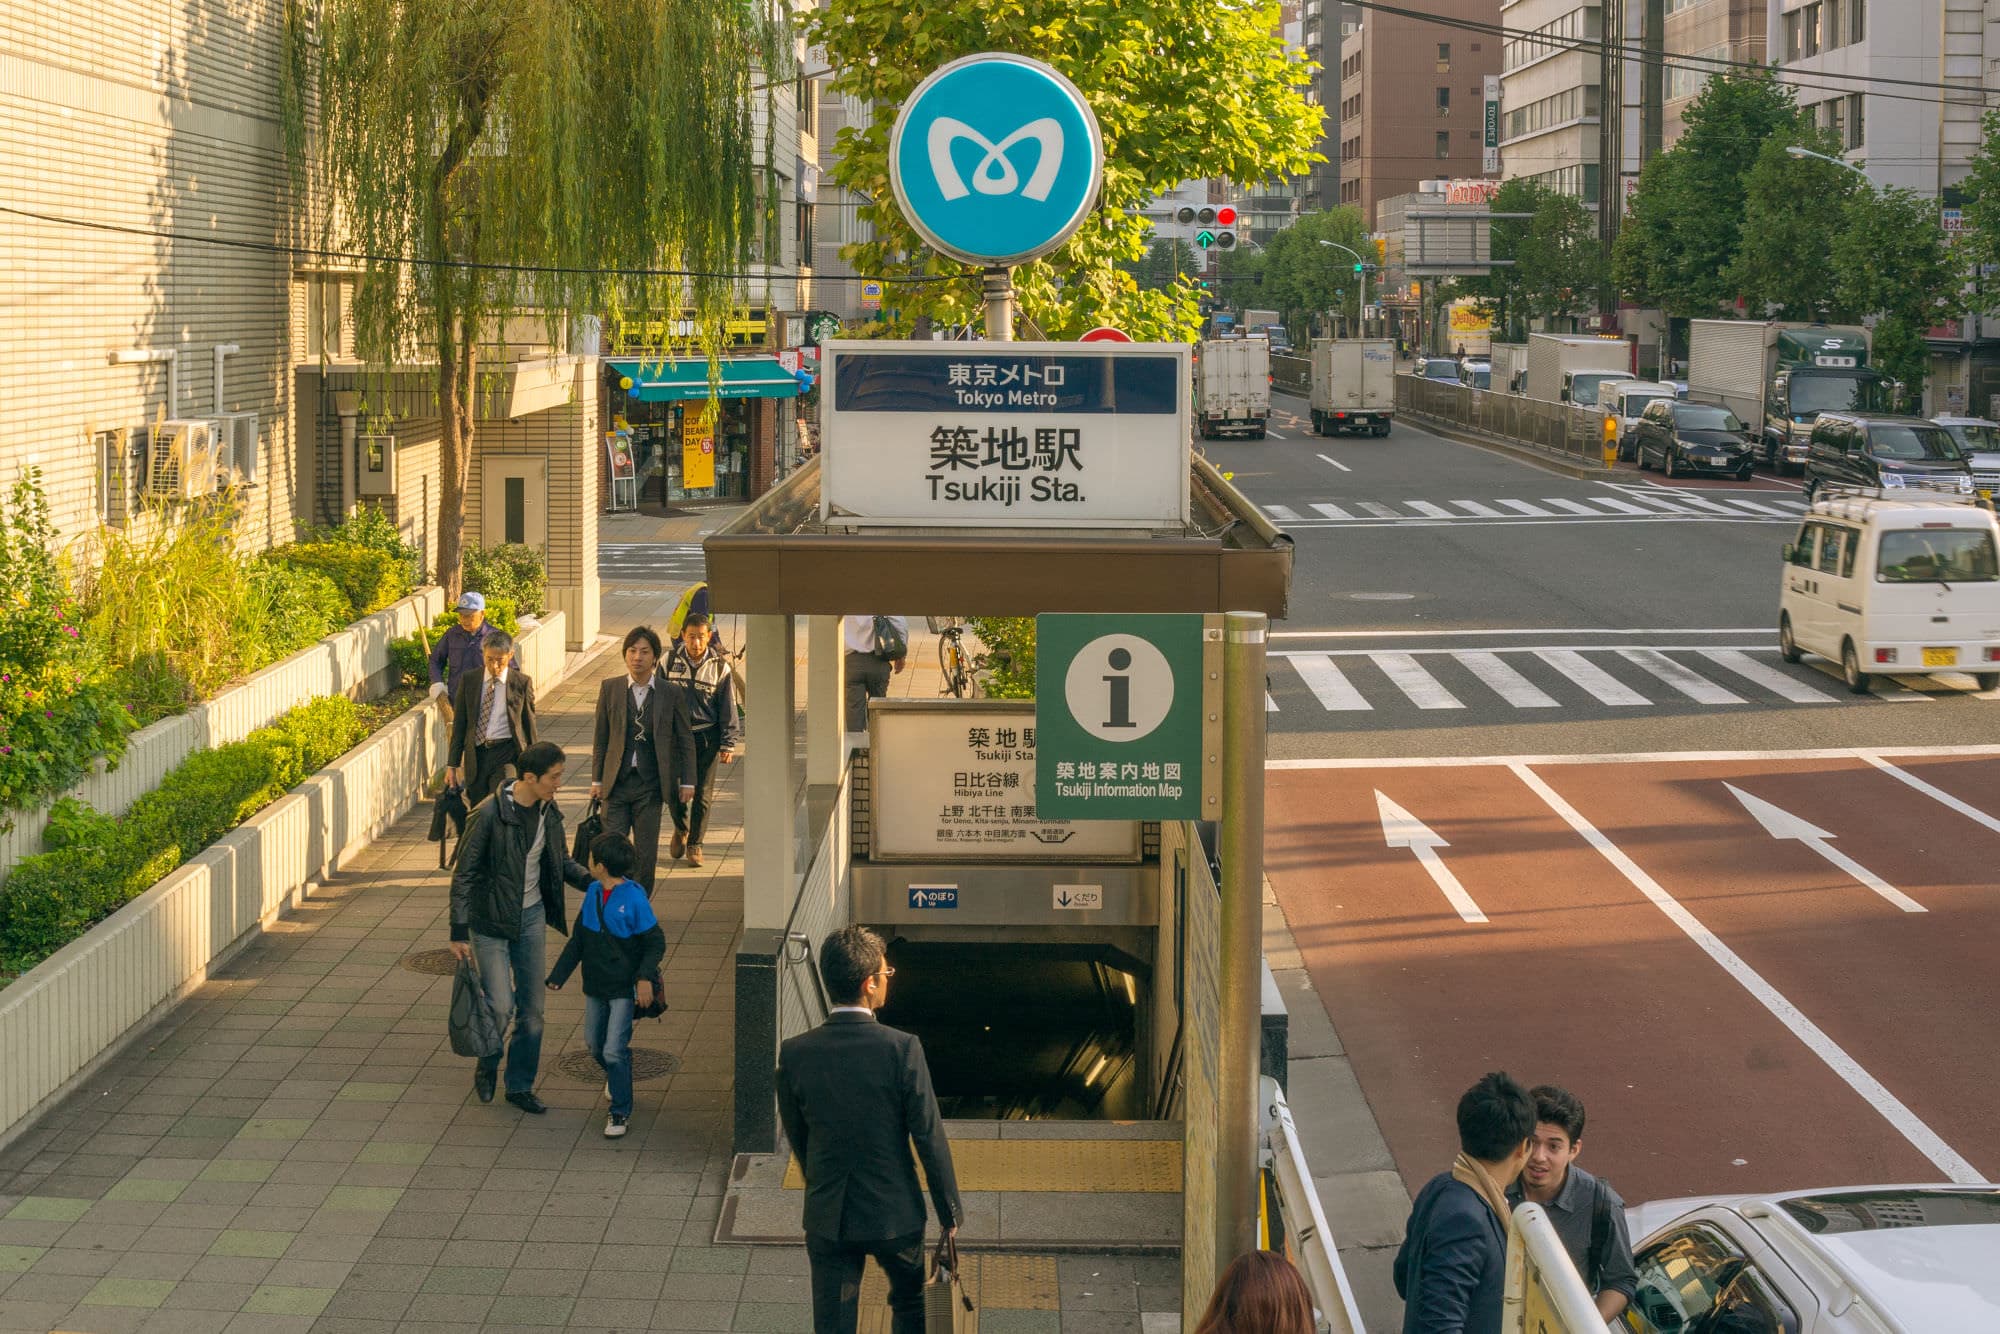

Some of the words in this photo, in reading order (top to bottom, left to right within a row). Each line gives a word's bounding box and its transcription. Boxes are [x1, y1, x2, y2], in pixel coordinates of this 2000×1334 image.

[1487, 105, 1496, 144] TOYOPET
[1445, 180, 1499, 206] Denny's
[948, 363, 1065, 386] 東京メトロ
[955, 389, 1004, 408] Tokyo
[1008, 389, 1058, 406] Metro
[685, 438, 701, 447] DAY
[929, 425, 1084, 472] 築地駅
[925, 475, 1020, 507] Tsukiji
[1030, 475, 1086, 502] Sta.
[975, 750, 1011, 762] Tsukiji
[1055, 761, 1182, 780] 築地案内地図
[954, 772, 1019, 788] 日比谷線
[954, 789, 983, 798] Hibiya
[985, 789, 1004, 797] Line
[1055, 782, 1091, 800] Tsukiji
[1094, 782, 1156, 797] Information
[1158, 783, 1183, 800] Map
[939, 805, 964, 817] 上野
[968, 805, 1006, 817] 北千住
[956, 829, 982, 838] 六本木
[928, 892, 955, 901] のぼり
[1074, 893, 1098, 902] くだり
